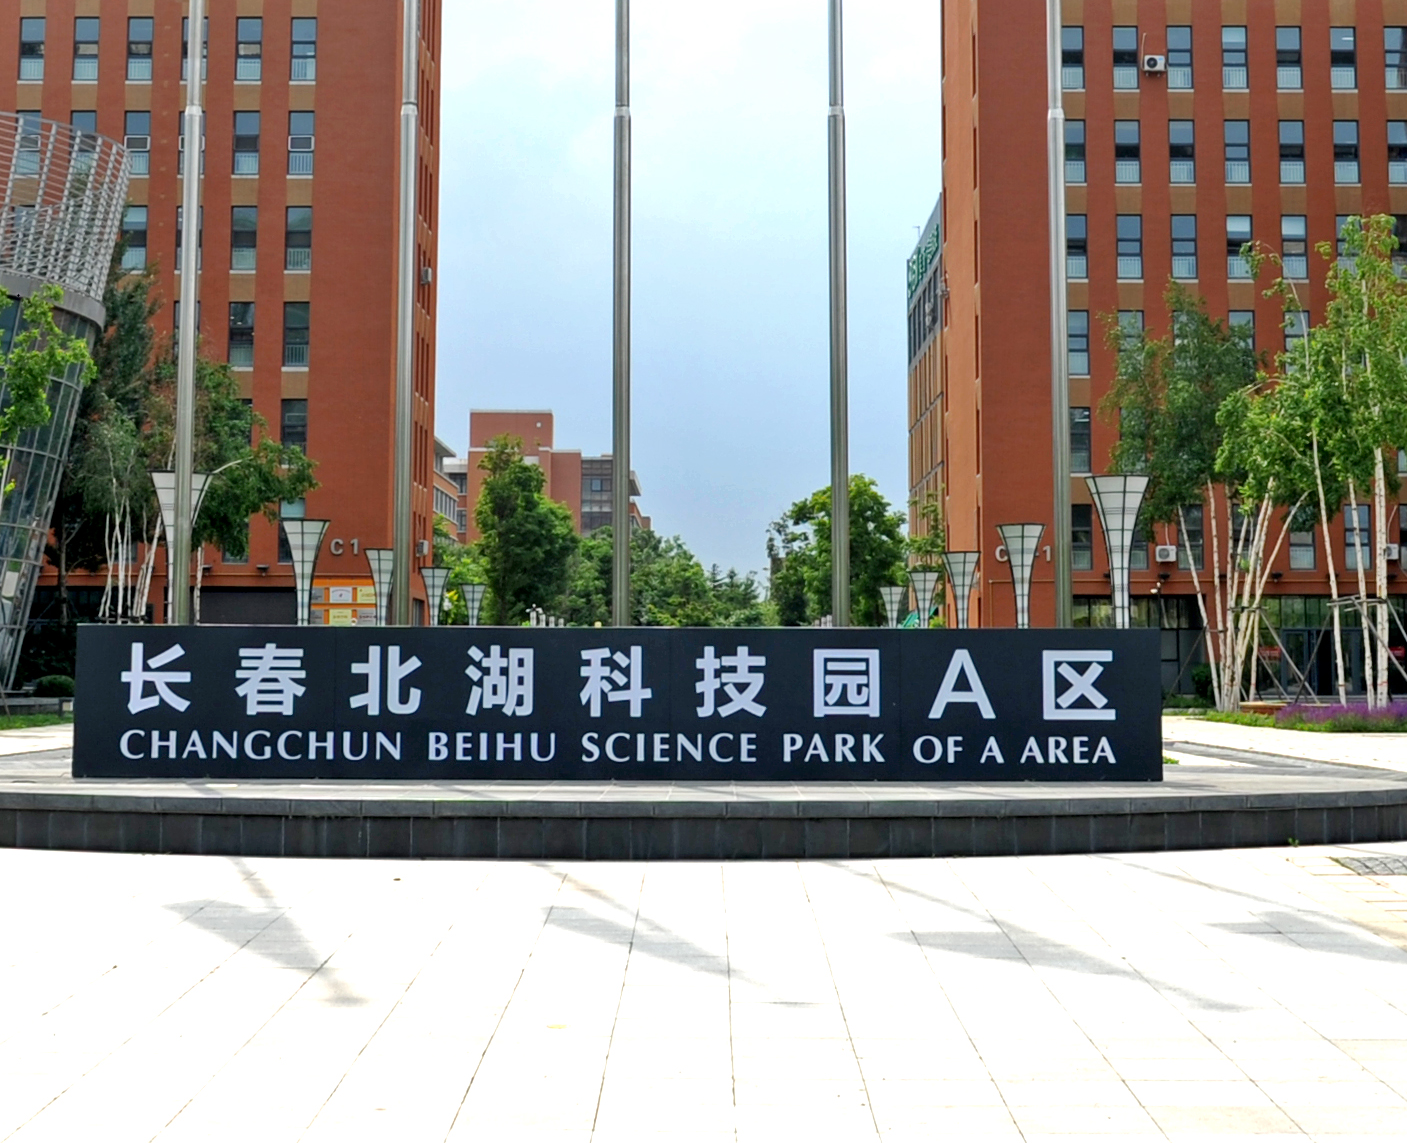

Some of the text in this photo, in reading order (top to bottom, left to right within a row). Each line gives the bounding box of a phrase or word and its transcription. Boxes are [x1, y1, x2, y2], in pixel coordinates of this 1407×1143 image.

[330, 538, 359, 555] C1
[121, 642, 1117, 719] 长春北湖科技园A区
[120, 729, 1117, 765] CHANGCHUN BEIHU SCIENCE PARK OF A AREA
